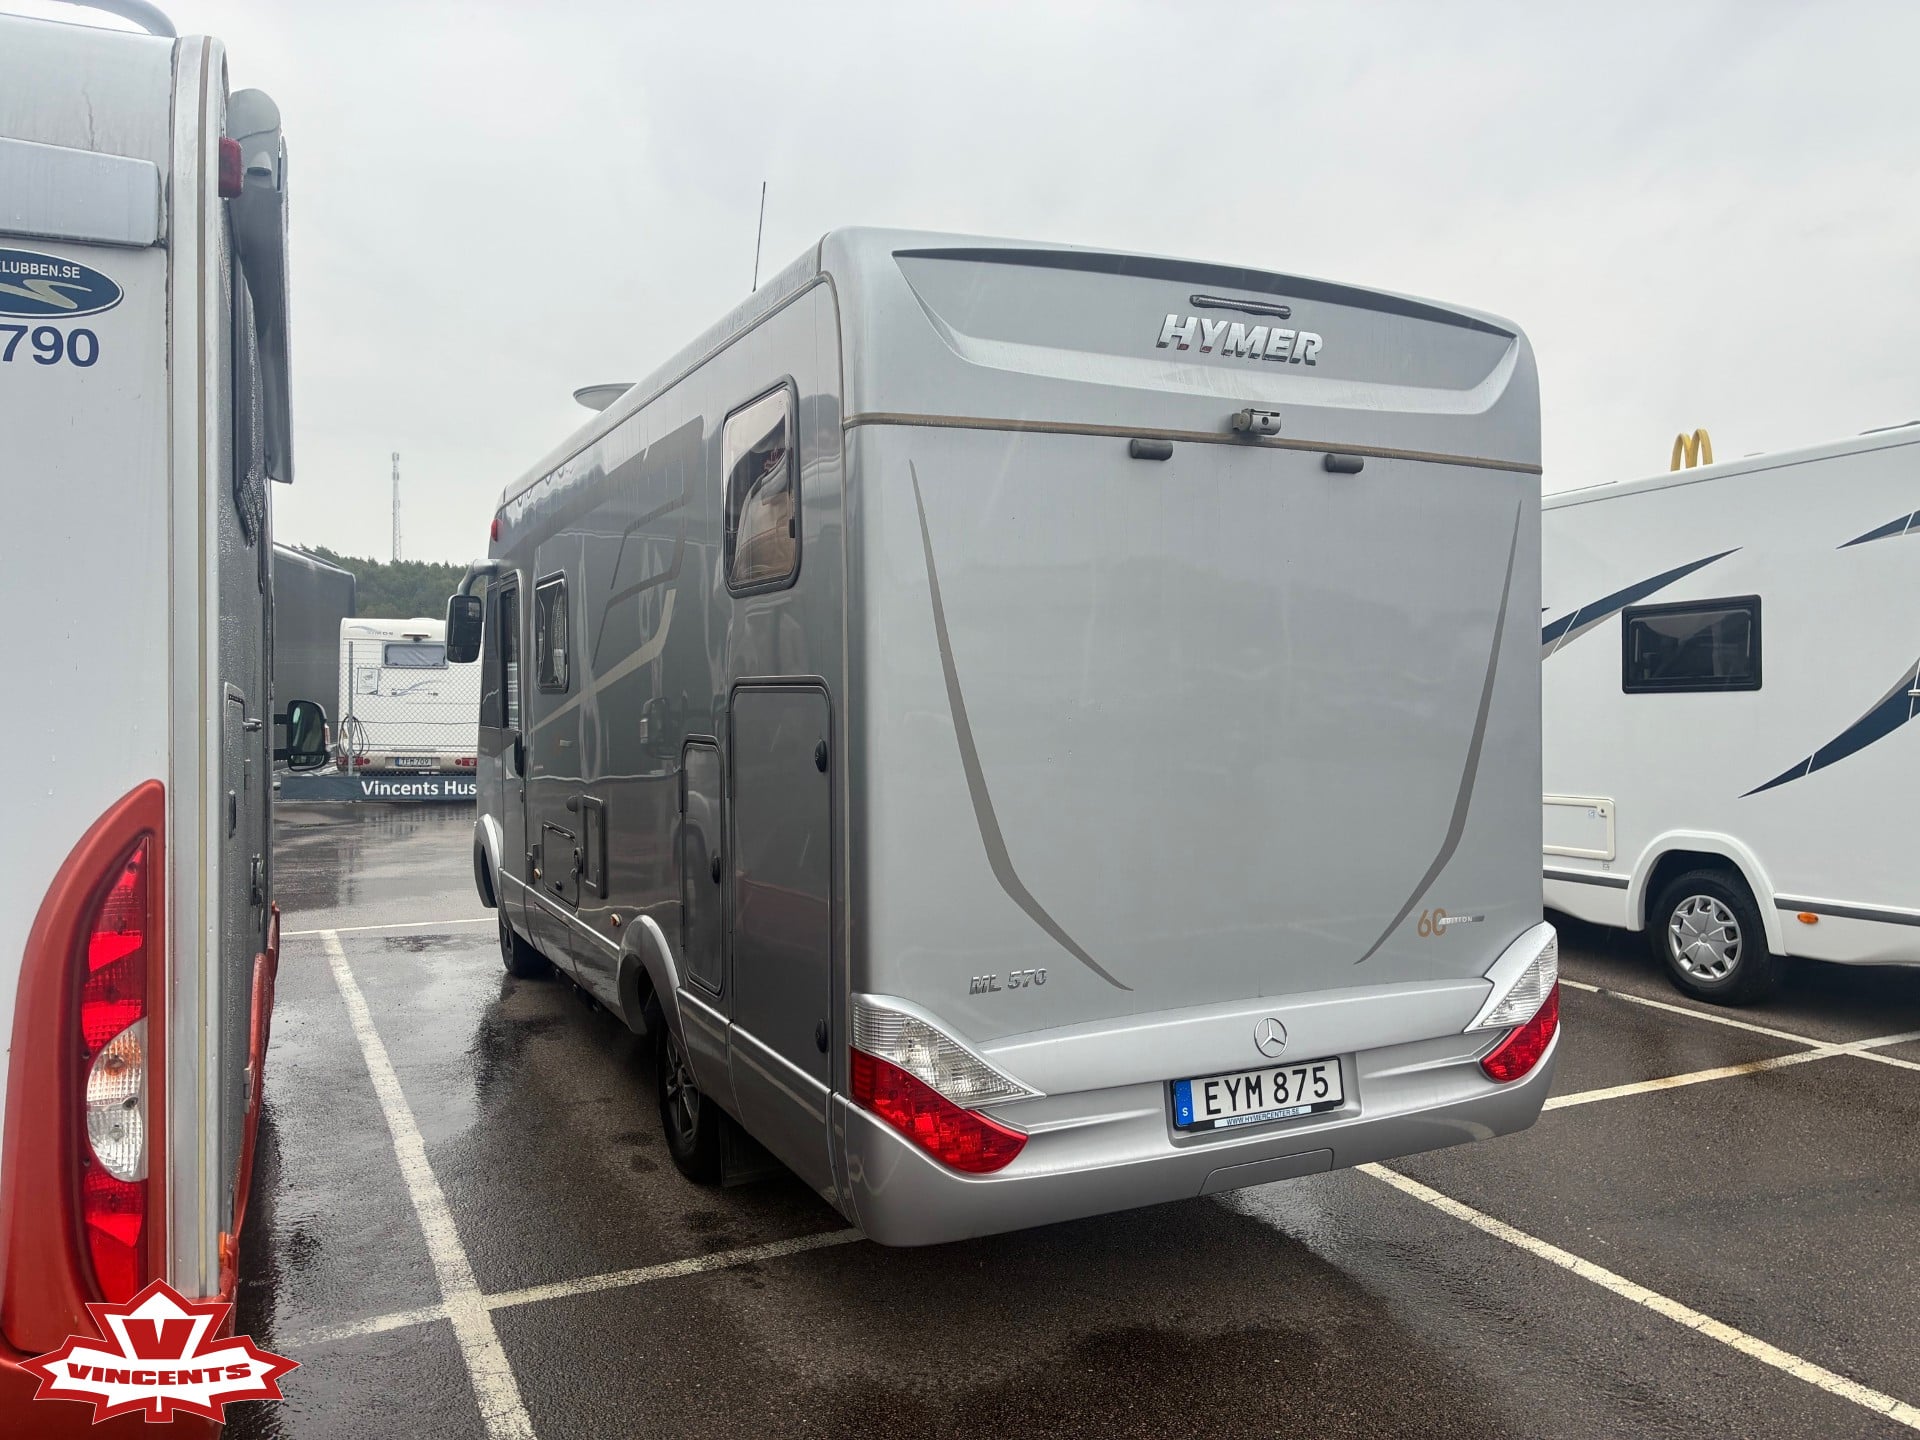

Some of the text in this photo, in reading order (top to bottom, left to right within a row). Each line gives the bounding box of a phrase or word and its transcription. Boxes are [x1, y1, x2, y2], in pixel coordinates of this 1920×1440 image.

[0, 324, 99, 367] 790
[1156, 314, 1323, 366] HYMER
[361, 780, 477, 795] Vincents Hus
[969, 968, 1047, 994] ML 570
[1205, 1066, 1329, 1115] EYM 875
[1182, 1107, 1189, 1117] S
